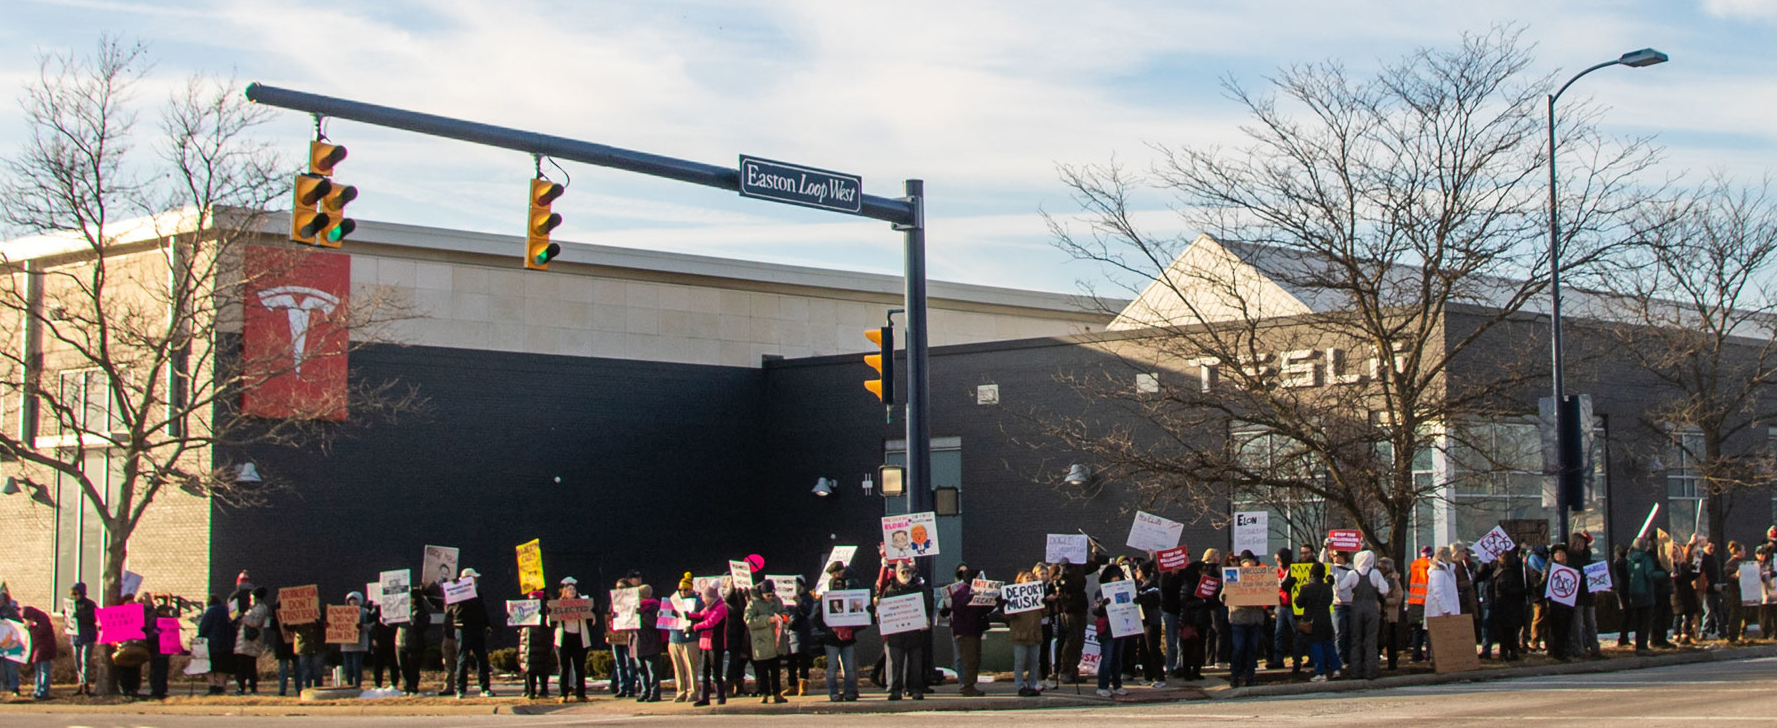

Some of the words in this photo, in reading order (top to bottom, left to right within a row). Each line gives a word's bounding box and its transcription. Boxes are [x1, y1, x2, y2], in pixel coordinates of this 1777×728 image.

[747, 163, 797, 193] Easton
[798, 173, 828, 203] Loop
[829, 178, 856, 202] West
[1005, 583, 1044, 599] DEPORT
[1006, 596, 1040, 611] MUSK
